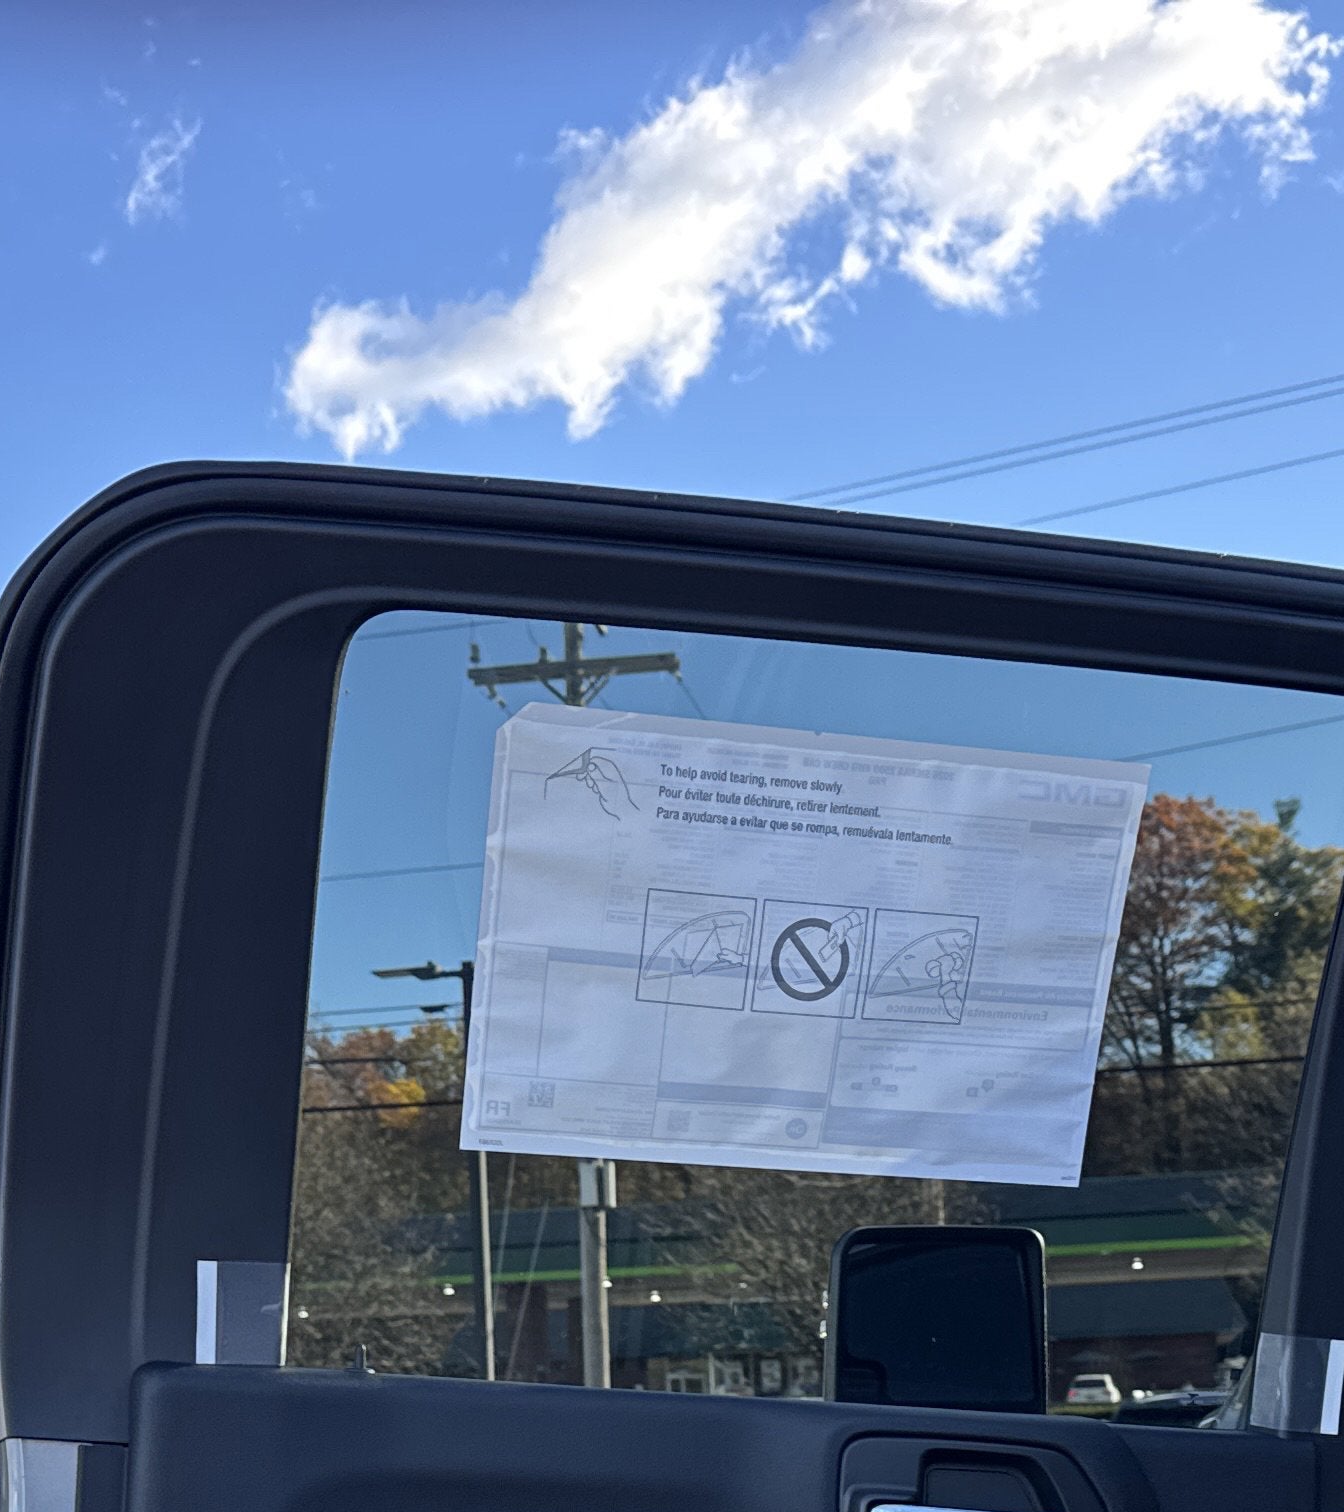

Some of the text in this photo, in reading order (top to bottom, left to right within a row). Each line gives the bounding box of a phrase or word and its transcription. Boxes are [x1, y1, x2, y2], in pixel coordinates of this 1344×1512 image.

[660, 764, 673, 777] To
[676, 766, 697, 781] help
[700, 770, 727, 782] avoid
[730, 772, 767, 788] tearing,
[770, 777, 808, 790] remove
[659, 785, 881, 818] Pour éviter toute déchirure, retirer lentement.
[656, 806, 679, 820] Para
[682, 811, 728, 825] ayudarse
[731, 816, 737, 826] a
[740, 816, 768, 829] evitar
[770, 819, 788, 832] que
[791, 822, 803, 831] se
[806, 823, 840, 837] rompa,
[843, 826, 893, 841] remuévala
